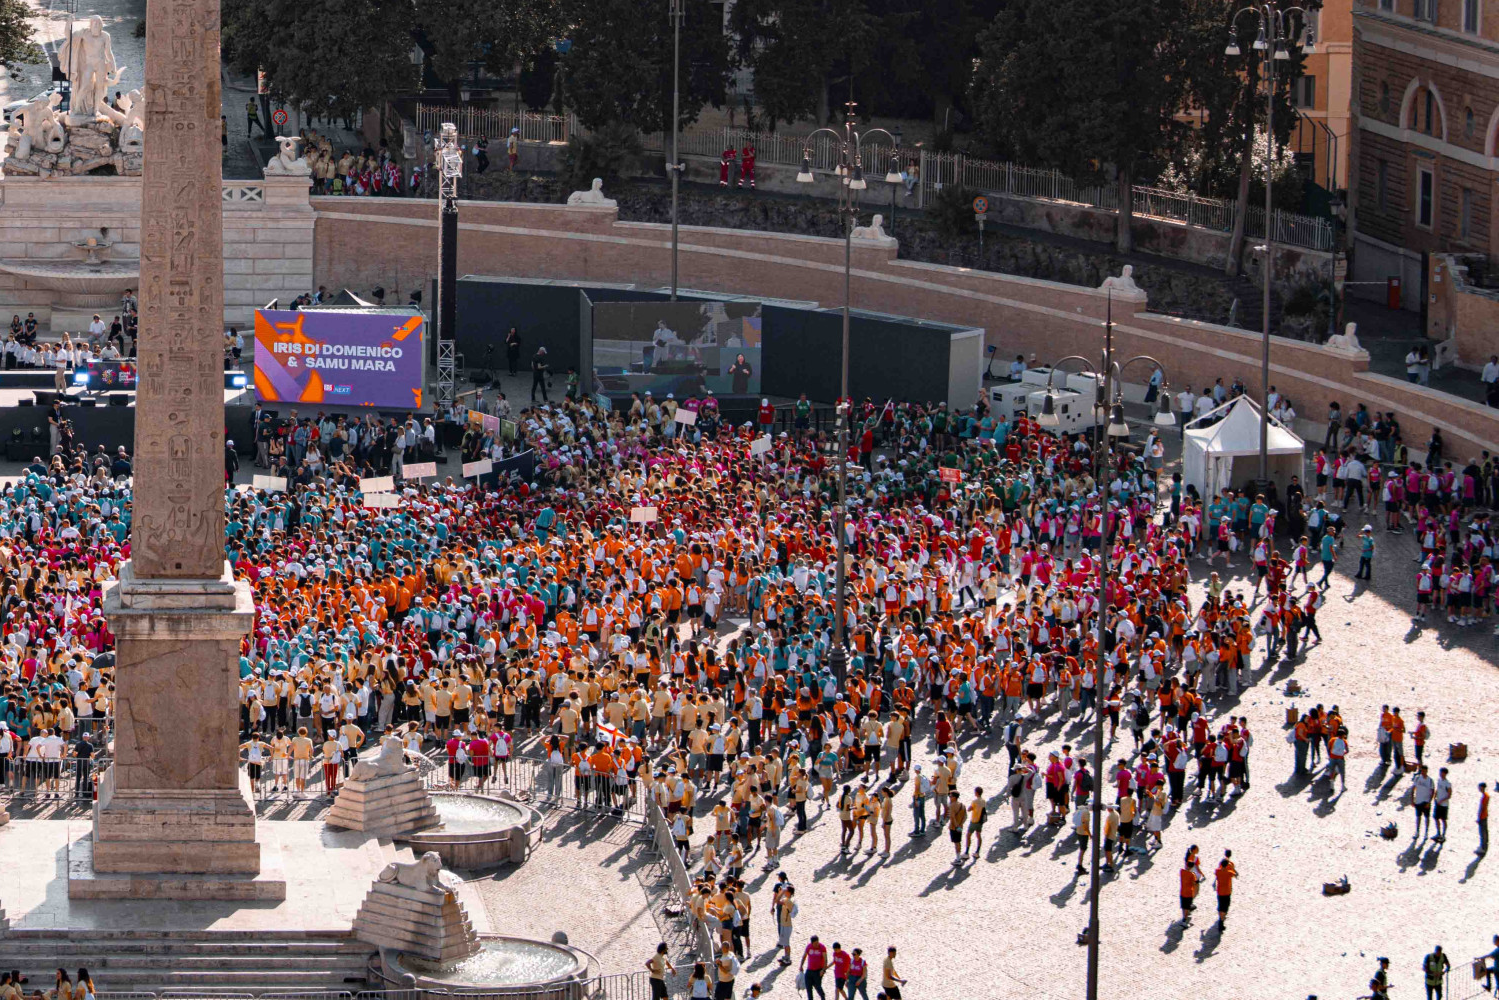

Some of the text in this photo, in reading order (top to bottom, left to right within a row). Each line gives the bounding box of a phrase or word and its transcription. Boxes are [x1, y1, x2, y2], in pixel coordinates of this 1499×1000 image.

[273, 342, 403, 358] IRIS DI DOMENICO
[287, 356, 396, 372] & SAMU MARA
